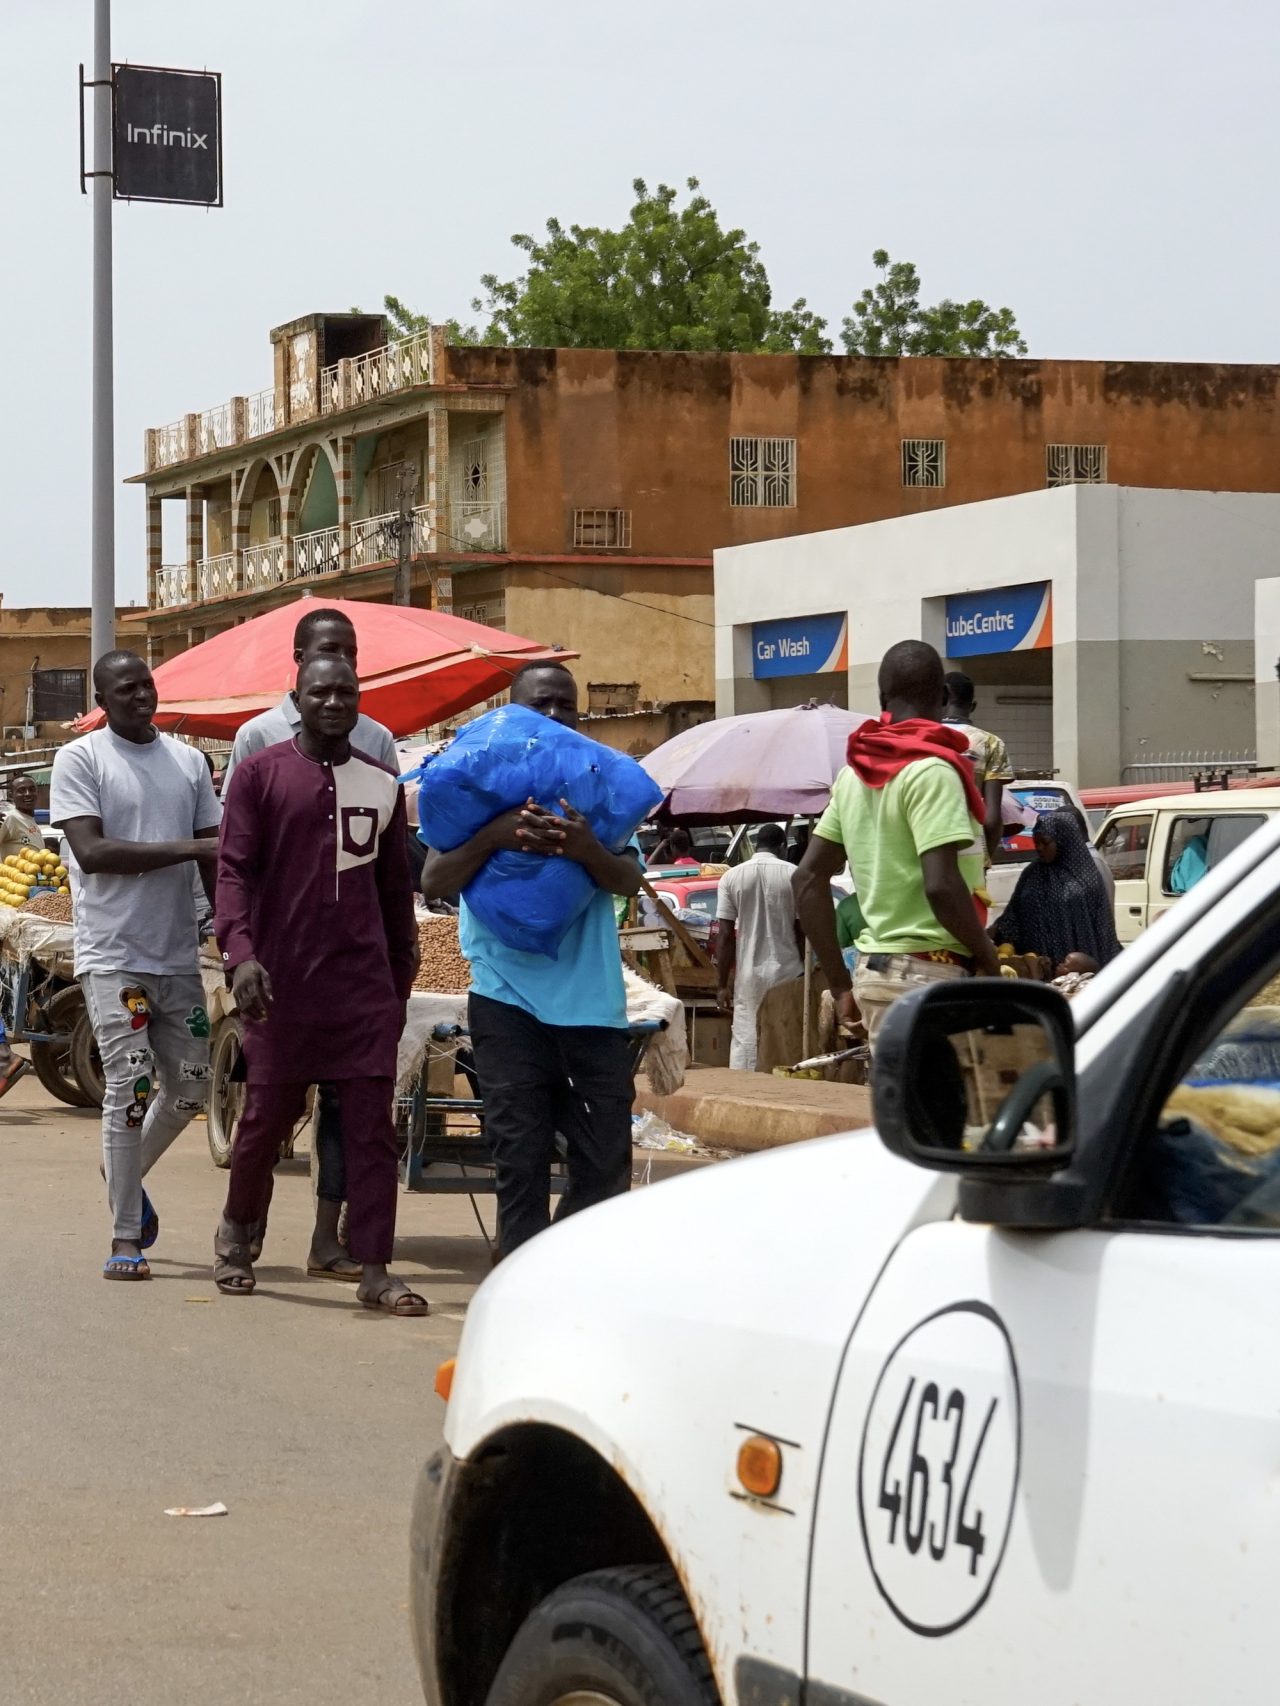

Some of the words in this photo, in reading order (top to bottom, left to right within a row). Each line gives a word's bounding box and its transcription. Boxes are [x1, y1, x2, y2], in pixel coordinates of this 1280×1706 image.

[127, 122, 209, 150] Infinix
[945, 610, 1016, 637] LubeCentre
[757, 639, 776, 660] Car
[778, 635, 810, 656] Wash
[878, 1375, 1000, 1577] 4634
